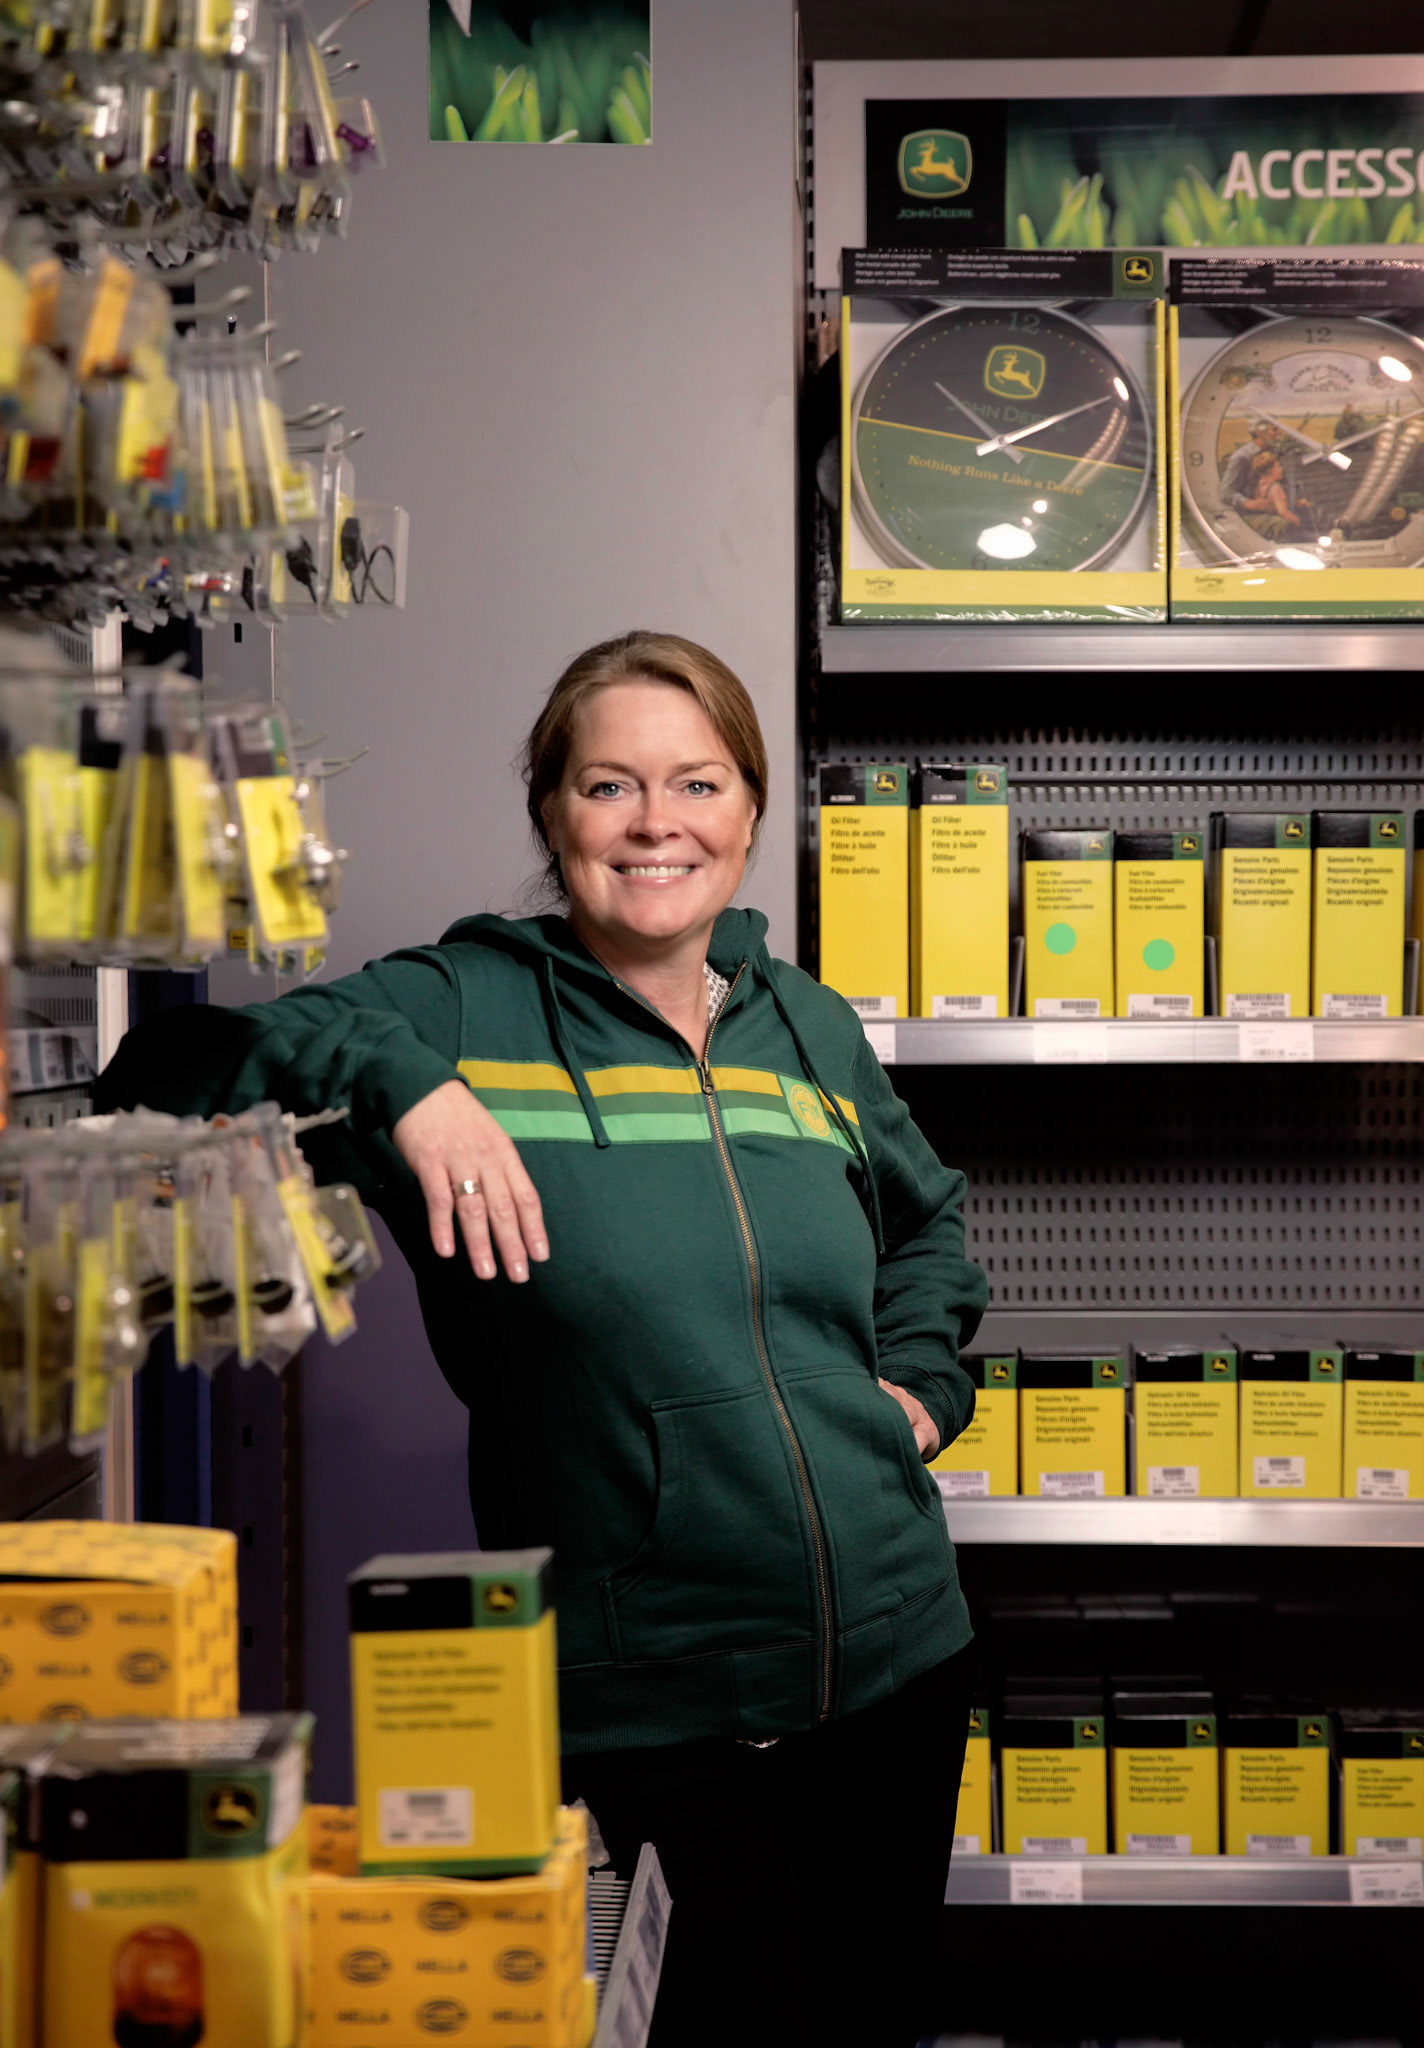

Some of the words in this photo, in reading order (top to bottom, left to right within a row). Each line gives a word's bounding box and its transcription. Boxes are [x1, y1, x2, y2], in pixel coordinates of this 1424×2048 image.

[896, 208, 932, 220] JOHN
[932, 207, 974, 219] DEERE
[1007, 311, 1041, 335] 12
[1304, 327, 1333, 344] 12
[1189, 450, 1204, 467] 9
[907, 454, 962, 476] Nothing
[963, 465, 1000, 482] Runs
[1001, 471, 1032, 489] Like
[1033, 480, 1044, 489] a
[1046, 482, 1085, 497] Deere
